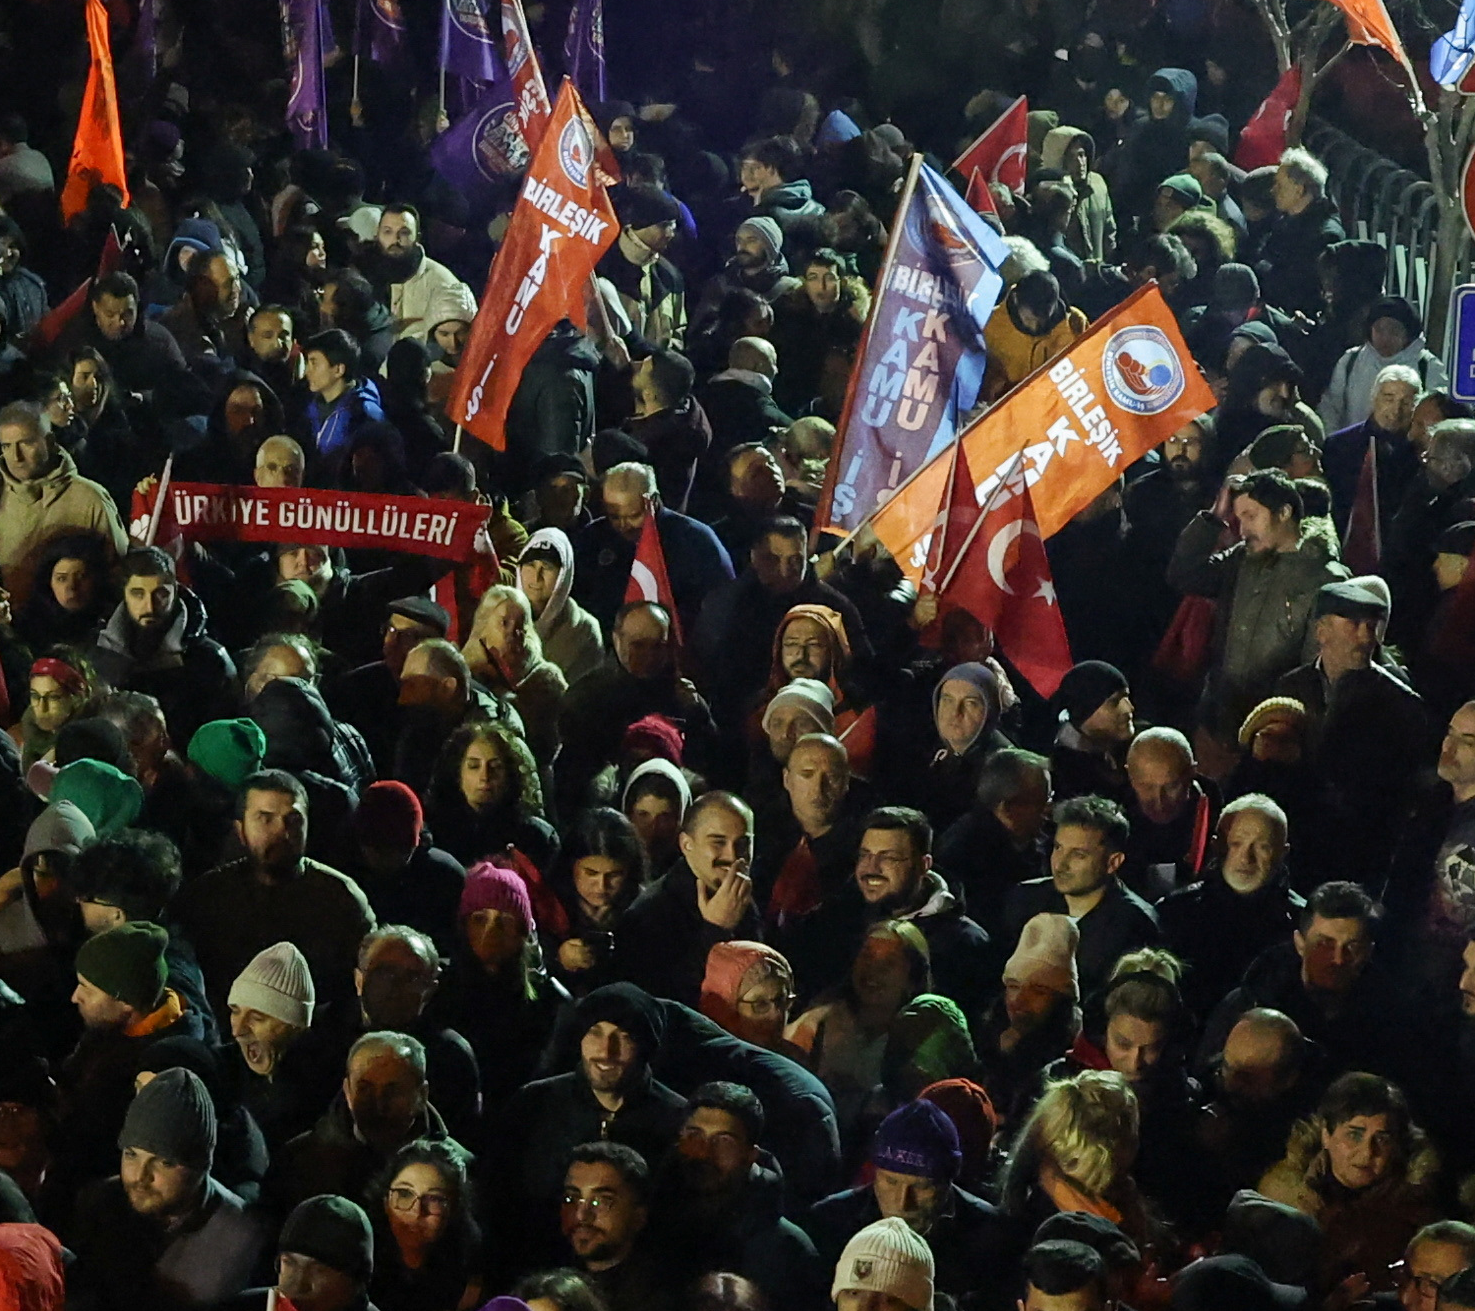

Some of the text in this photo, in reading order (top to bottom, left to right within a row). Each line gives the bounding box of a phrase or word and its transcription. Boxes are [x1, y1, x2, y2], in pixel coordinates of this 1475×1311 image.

[522, 175, 609, 246] BİRLEŞİK
[464, 352, 498, 422] İŞ
[861, 305, 925, 429] KAMU
[896, 308, 950, 431] KAMU
[1048, 357, 1125, 468] BİRLEŞİK
[830, 449, 864, 523] İŞ
[974, 414, 1081, 512] KAMU
[173, 489, 460, 546] ÜRKİYE GÖNÜLLÜLERİ
